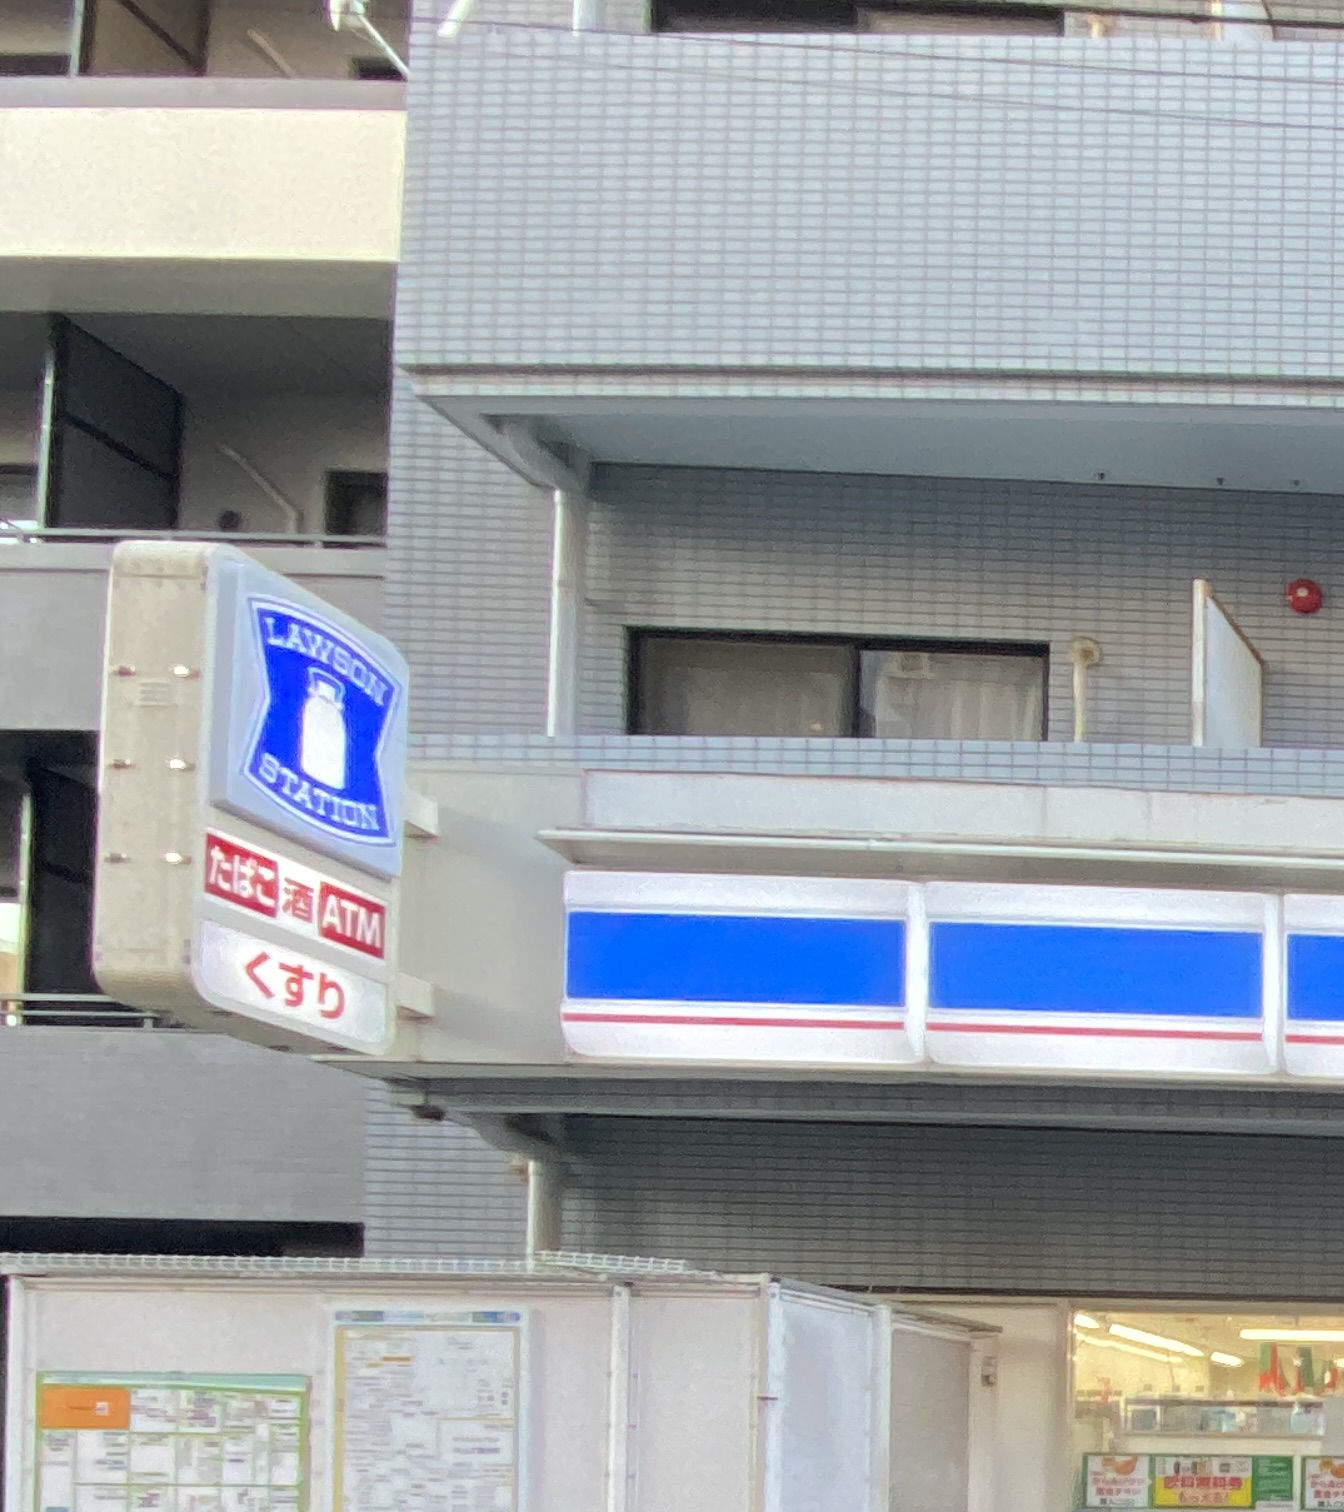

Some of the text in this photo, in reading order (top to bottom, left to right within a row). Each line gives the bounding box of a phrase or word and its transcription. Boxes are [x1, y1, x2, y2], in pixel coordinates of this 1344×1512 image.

[263, 616, 391, 707] LAWSON
[258, 751, 381, 832] STATION
[209, 845, 383, 949] たばこ 酒 ATM
[244, 951, 346, 1020] くすり
